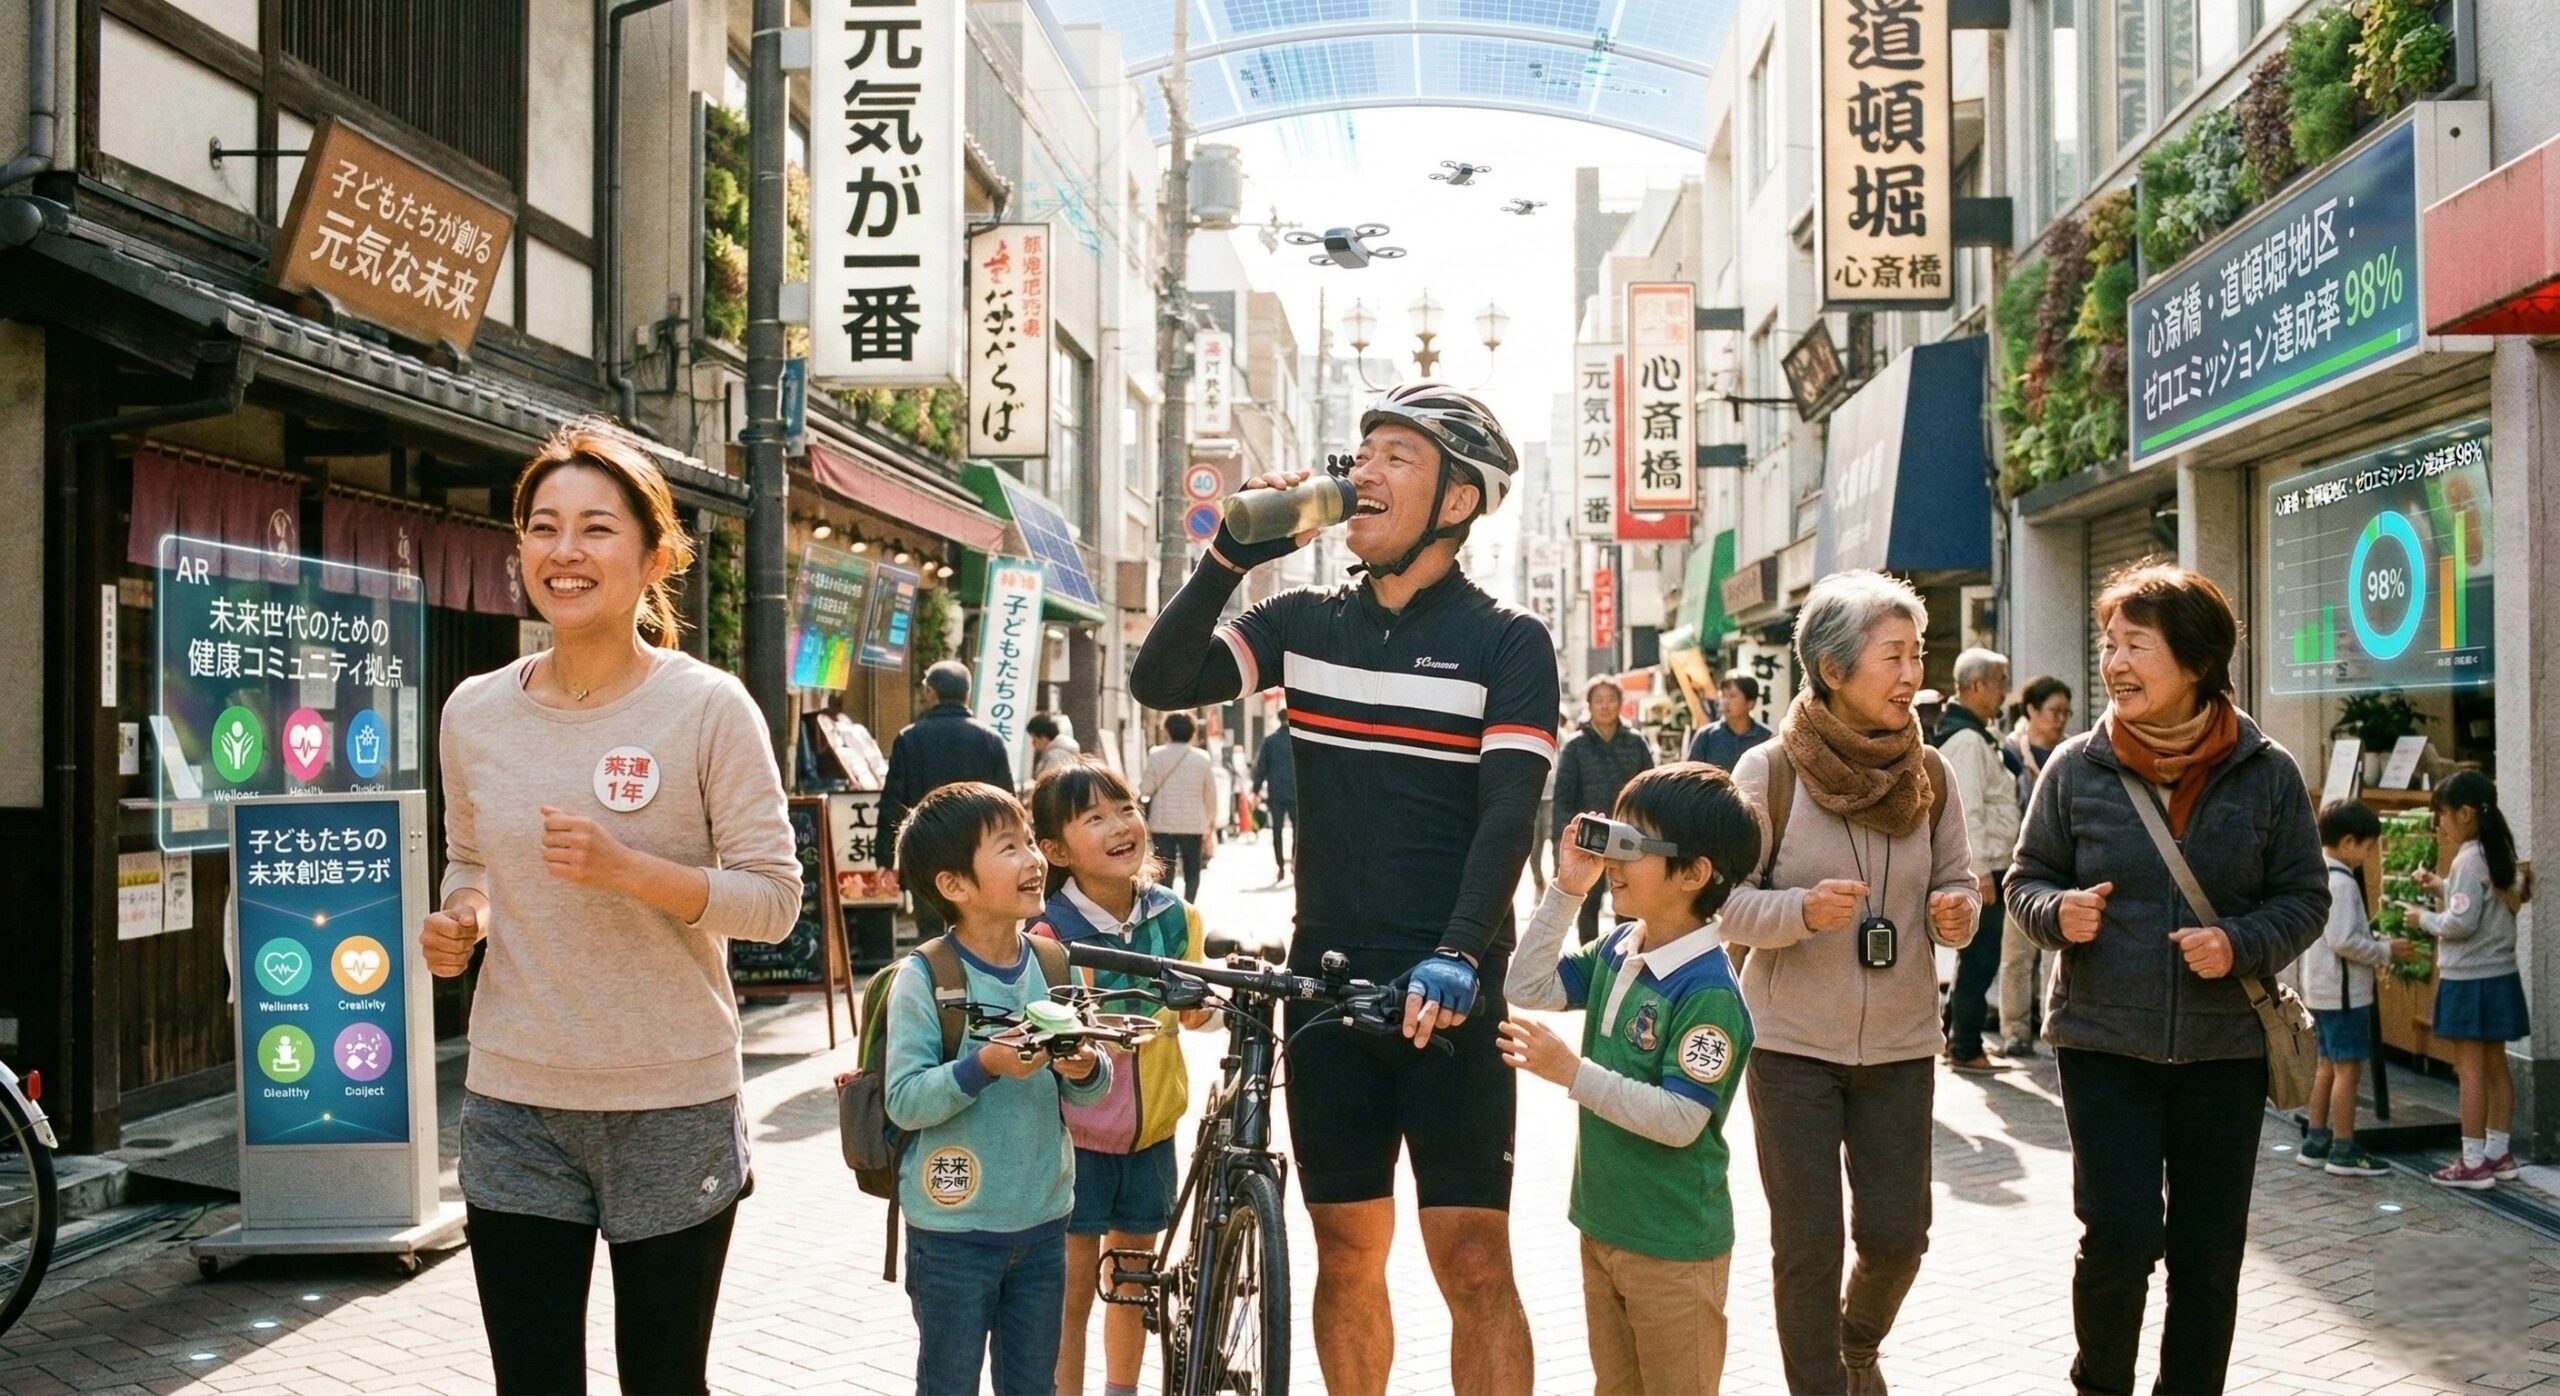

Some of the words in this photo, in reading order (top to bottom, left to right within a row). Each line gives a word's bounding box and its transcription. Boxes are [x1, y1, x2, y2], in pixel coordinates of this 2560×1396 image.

[1847, 0, 1926, 238] 道頓堀
[842, 0, 923, 363] 元気が一番
[331, 159, 494, 265] 子どもたちが創る
[310, 209, 479, 320] 元気な未来
[1834, 253, 1942, 288] 心斎橋
[1641, 355, 1683, 491] 心斎橋
[1583, 362, 1611, 524] 元気が一番
[1193, 475, 1212, 490] 40
[176, 556, 210, 586] AR
[2367, 568, 2405, 602] 98%
[209, 596, 389, 647] 未来世代のための
[188, 638, 404, 688] 健康コミュニティ拠点
[608, 781, 644, 803] 1年
[248, 828, 387, 854] 子どもたちの
[248, 858, 391, 886] 未来創造ラボ
[1690, 1034, 1726, 1059] 未来
[932, 1157, 968, 1175] 未来
